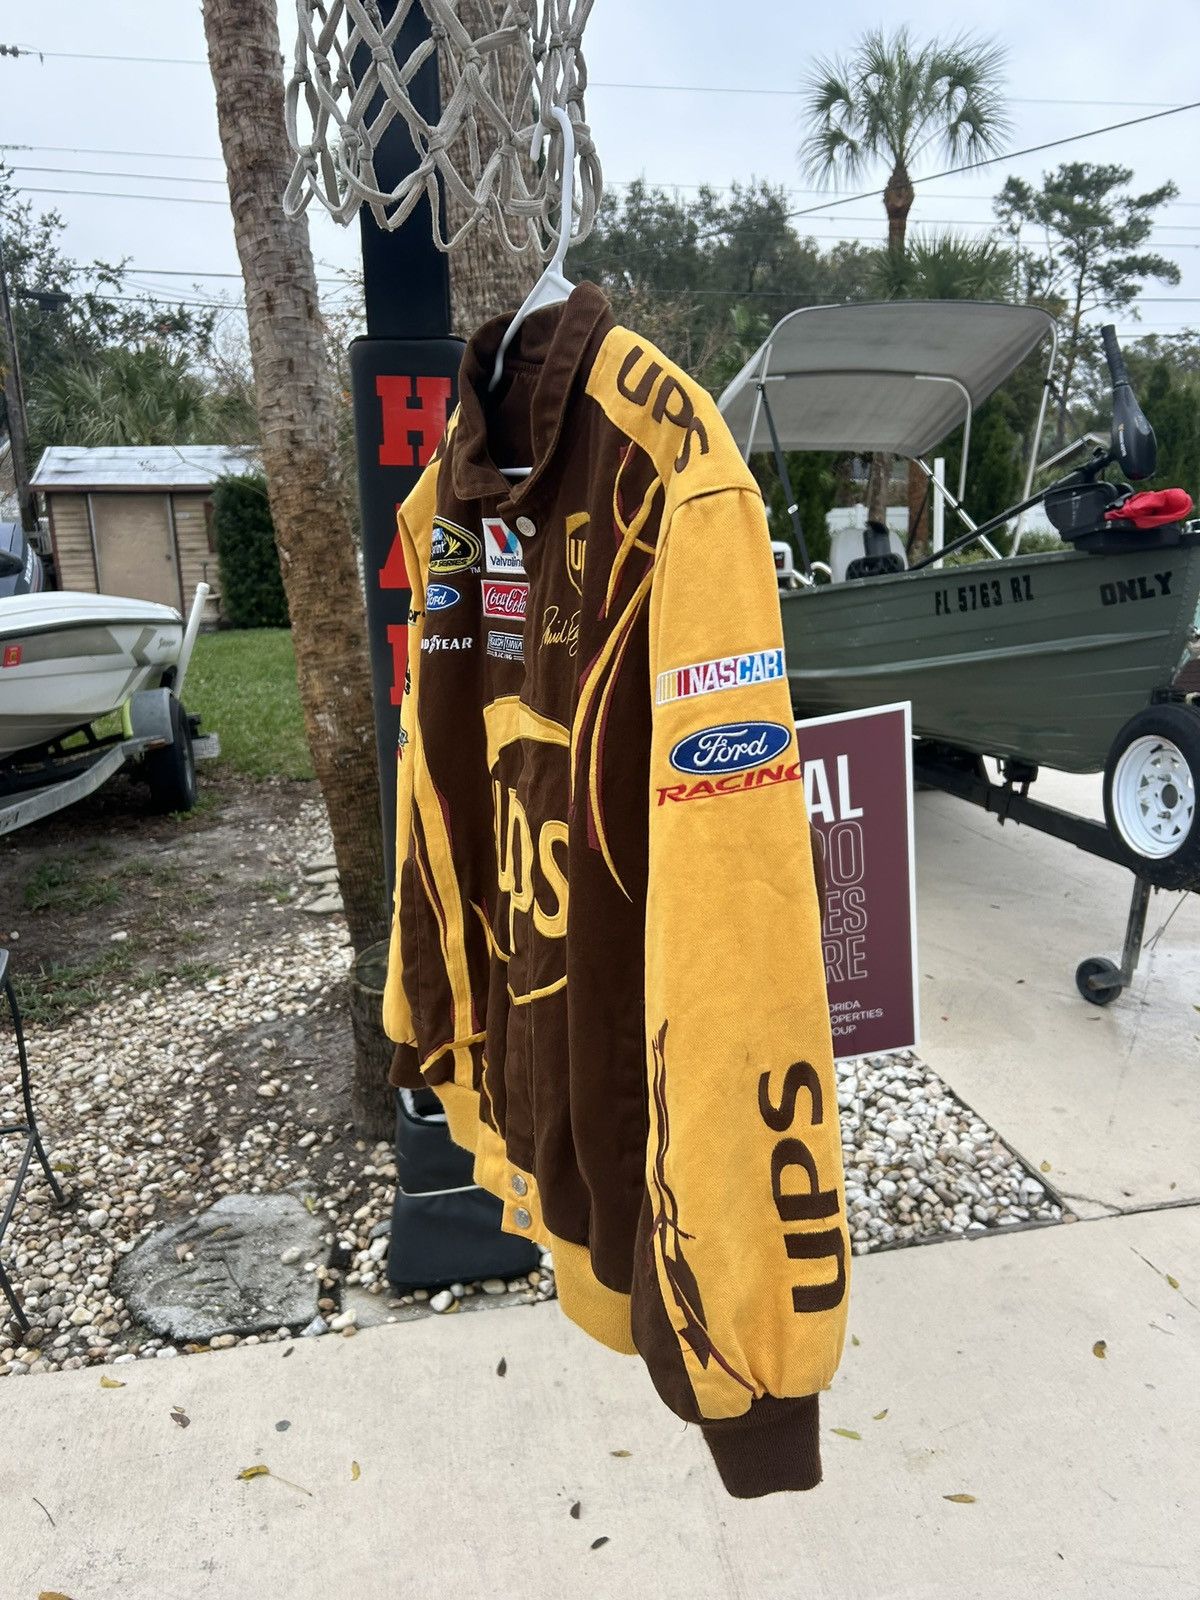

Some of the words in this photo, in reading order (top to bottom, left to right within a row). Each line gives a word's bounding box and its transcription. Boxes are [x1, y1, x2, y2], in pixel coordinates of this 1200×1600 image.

[935, 590, 951, 616] FL
[958, 580, 1003, 612] 5763
[1010, 574, 1034, 603] RZ
[1100, 571, 1172, 606] ONLY
[688, 651, 782, 696] NASCAR
[693, 729, 768, 767] Ford
